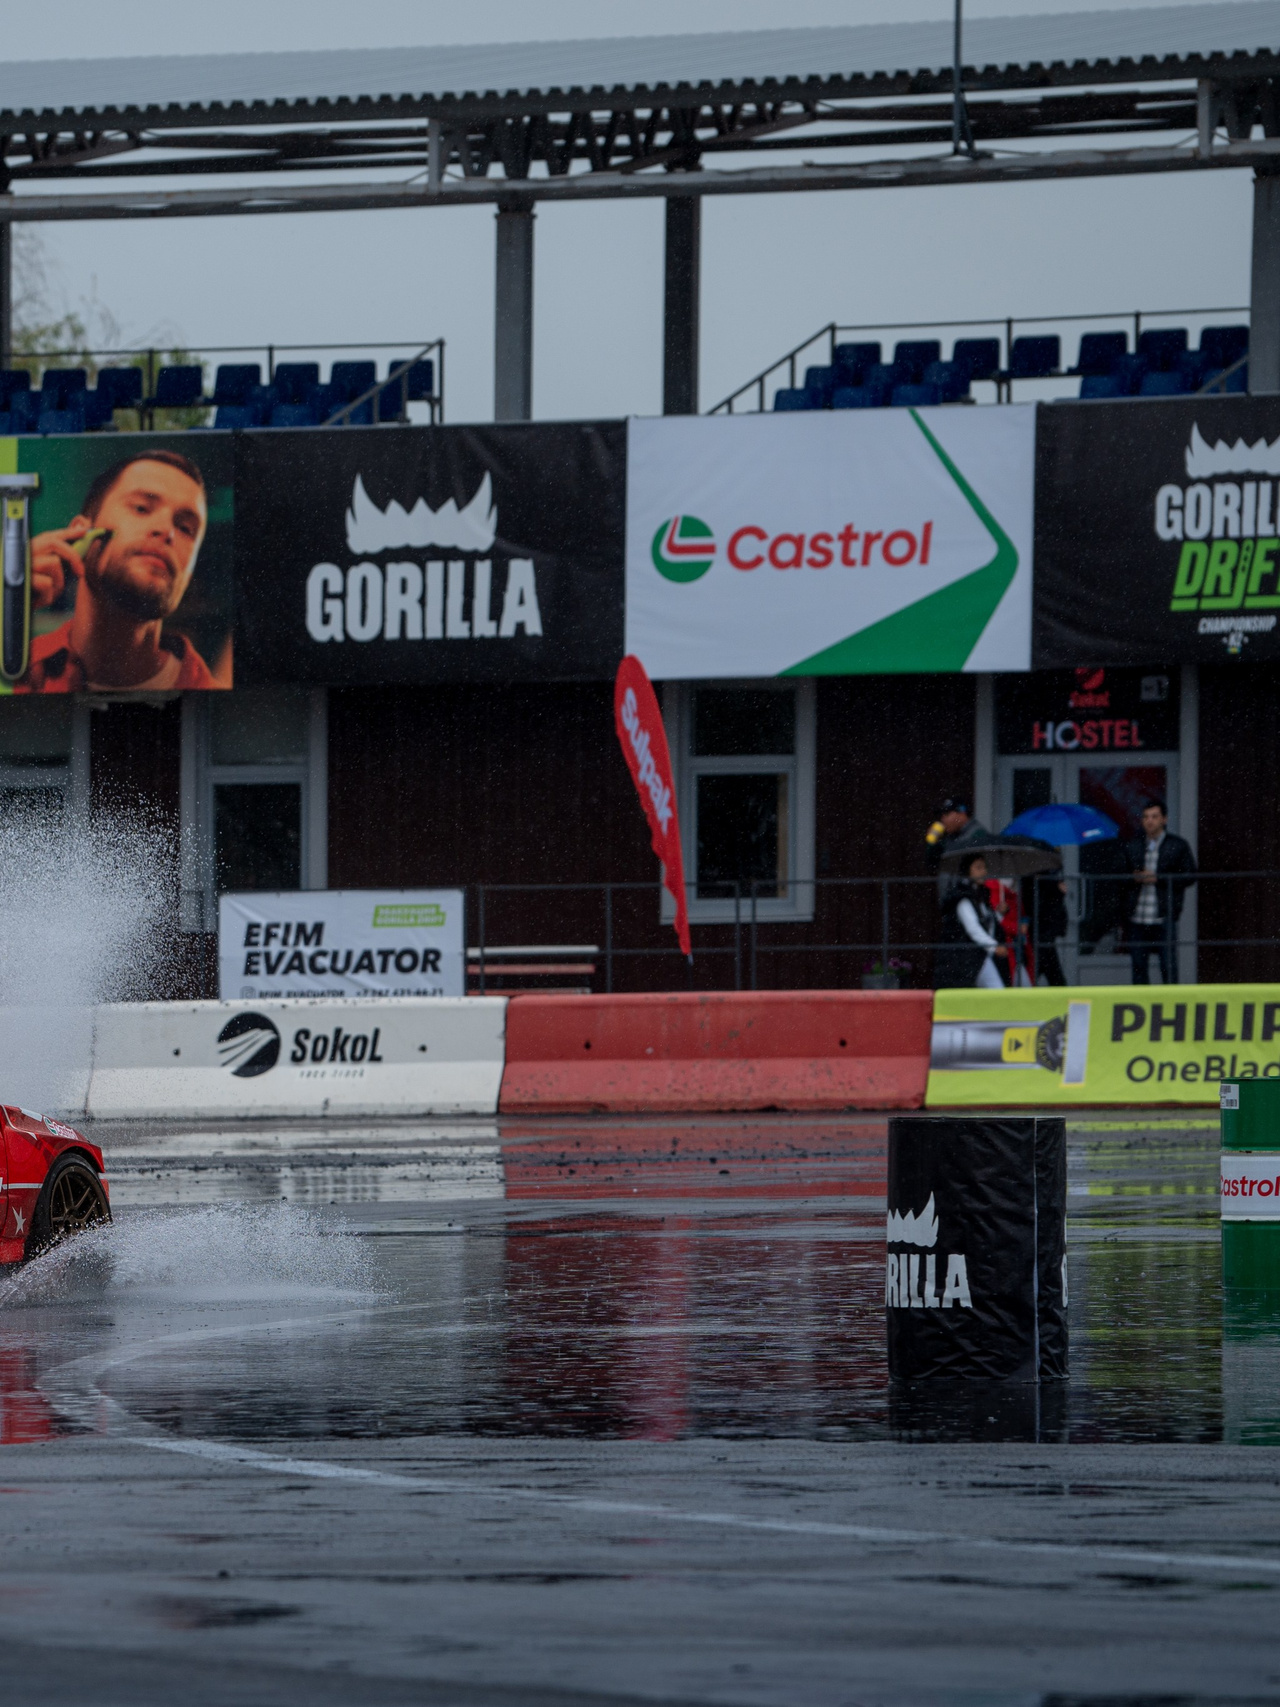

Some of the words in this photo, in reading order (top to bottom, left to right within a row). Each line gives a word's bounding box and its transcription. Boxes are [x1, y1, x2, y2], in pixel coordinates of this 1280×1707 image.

[1155, 480, 1280, 541] GORIL
[726, 519, 934, 571] Castrol
[1171, 538, 1280, 612] DRIF
[305, 557, 543, 643] GORILLA
[1032, 720, 1142, 749] HOSTEL
[243, 920, 325, 948] EFIM
[243, 948, 442, 977] EVACUATOR
[1221, 1175, 1280, 1197] astrol
